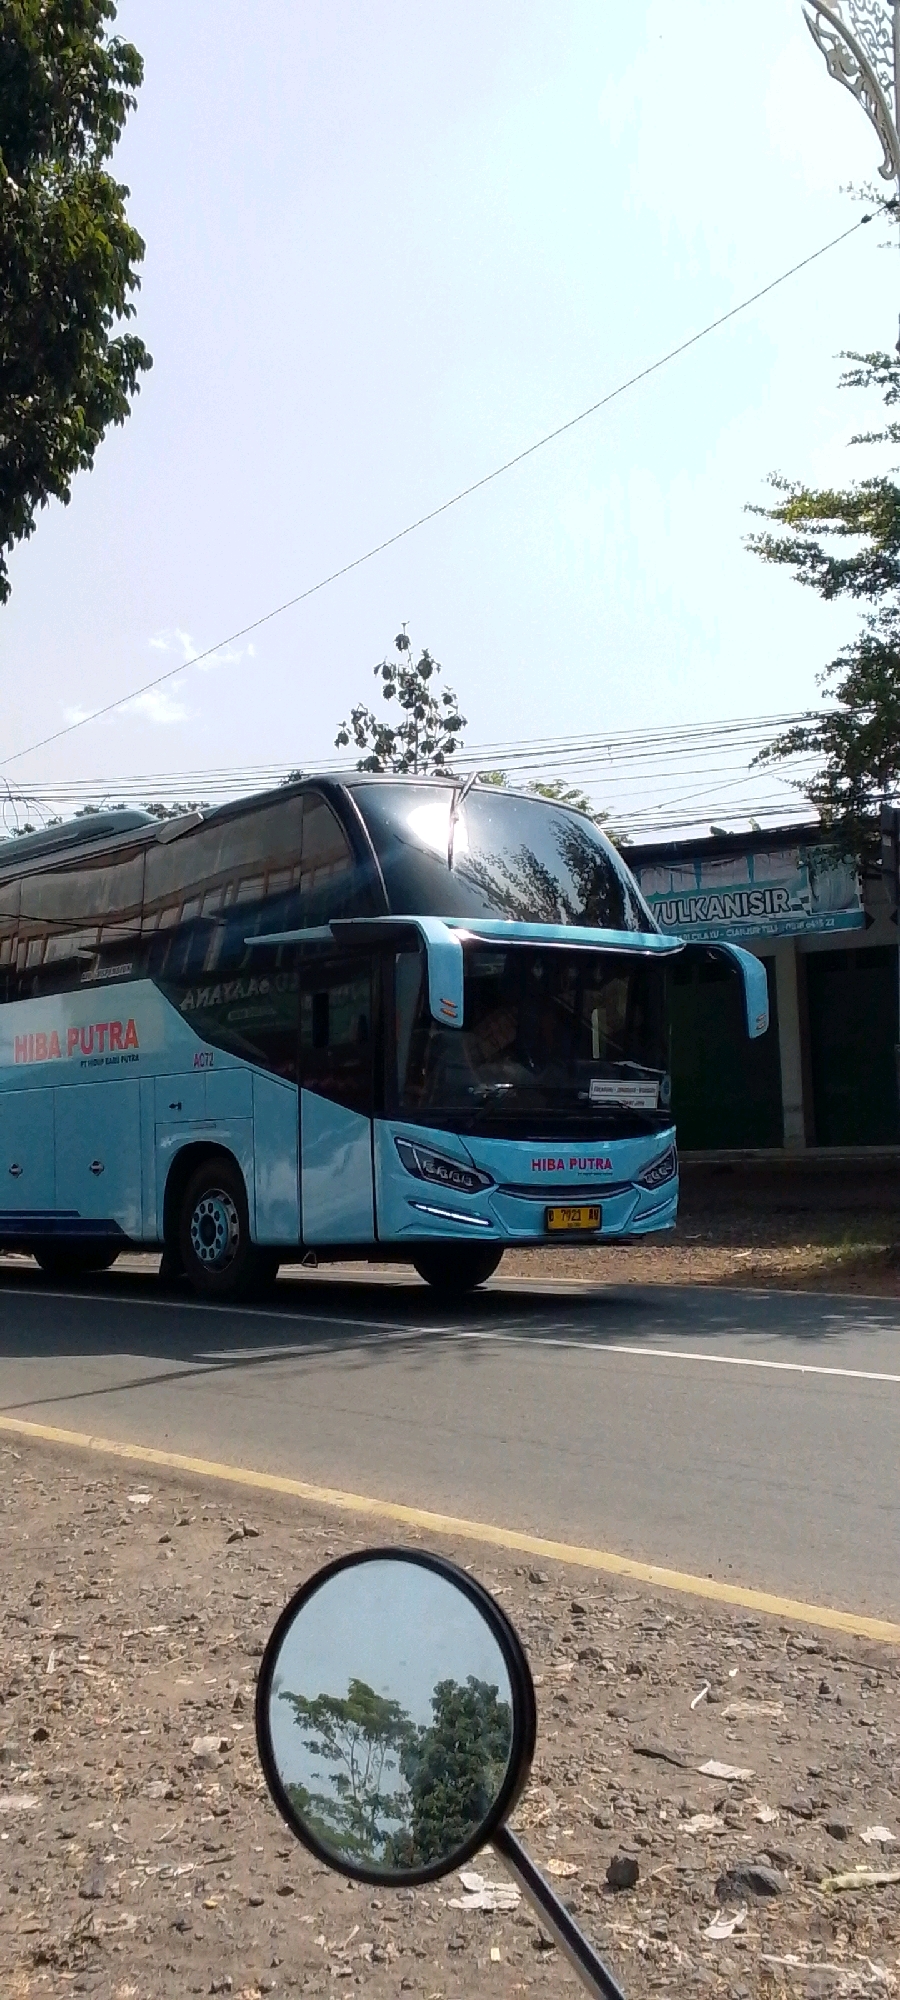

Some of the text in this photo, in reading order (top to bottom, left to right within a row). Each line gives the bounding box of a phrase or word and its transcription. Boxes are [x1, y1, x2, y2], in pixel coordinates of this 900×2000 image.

[14, 1018, 139, 1064] HIBA PUTRA
[121, 1054, 139, 1063] PUTRA
[531, 1157, 613, 1171] HIBA PUTRA
